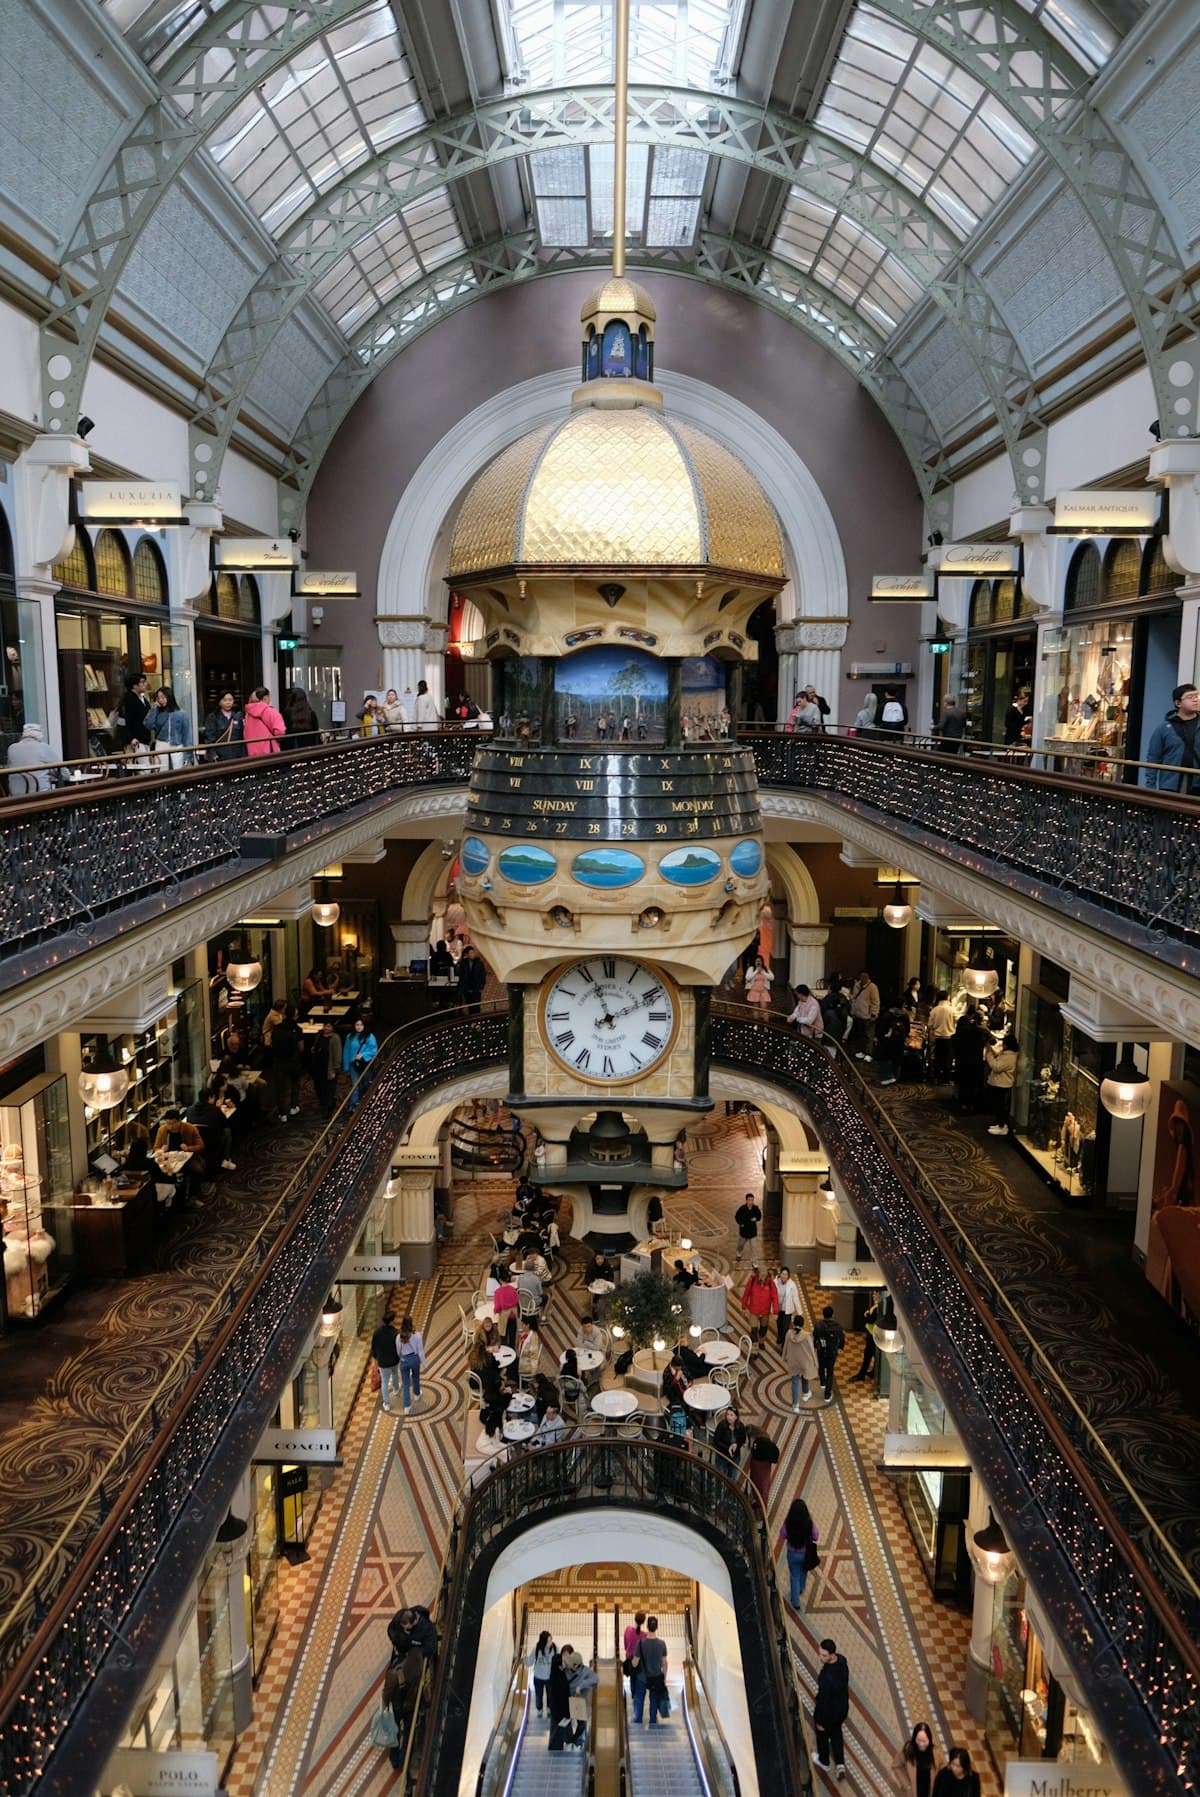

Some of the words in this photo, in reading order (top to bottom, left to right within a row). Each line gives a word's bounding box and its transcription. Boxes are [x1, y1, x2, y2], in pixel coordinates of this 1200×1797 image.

[1063, 503, 1096, 512] KALMAR
[1097, 504, 1139, 513] ANTIQUES
[579, 758, 593, 769] IX
[660, 759, 670, 770] X
[575, 780, 594, 791] VIII
[661, 780, 673, 791] IX
[532, 799, 577, 812] SUNDAY
[671, 800, 715, 812] MONDAY
[501, 818, 512, 829] 25
[525, 821, 537, 832] 26
[554, 822, 568, 833] 27
[587, 823, 601, 834] 28
[621, 824, 635, 834] 29
[655, 824, 668, 834] 30
[648, 1012, 667, 1021] III
[353, 1265, 396, 1273] COACH
[274, 1442, 330, 1451] COACH
[159, 1770, 198, 1781] POLO
[1030, 1777, 1112, 1797] Mulberry
